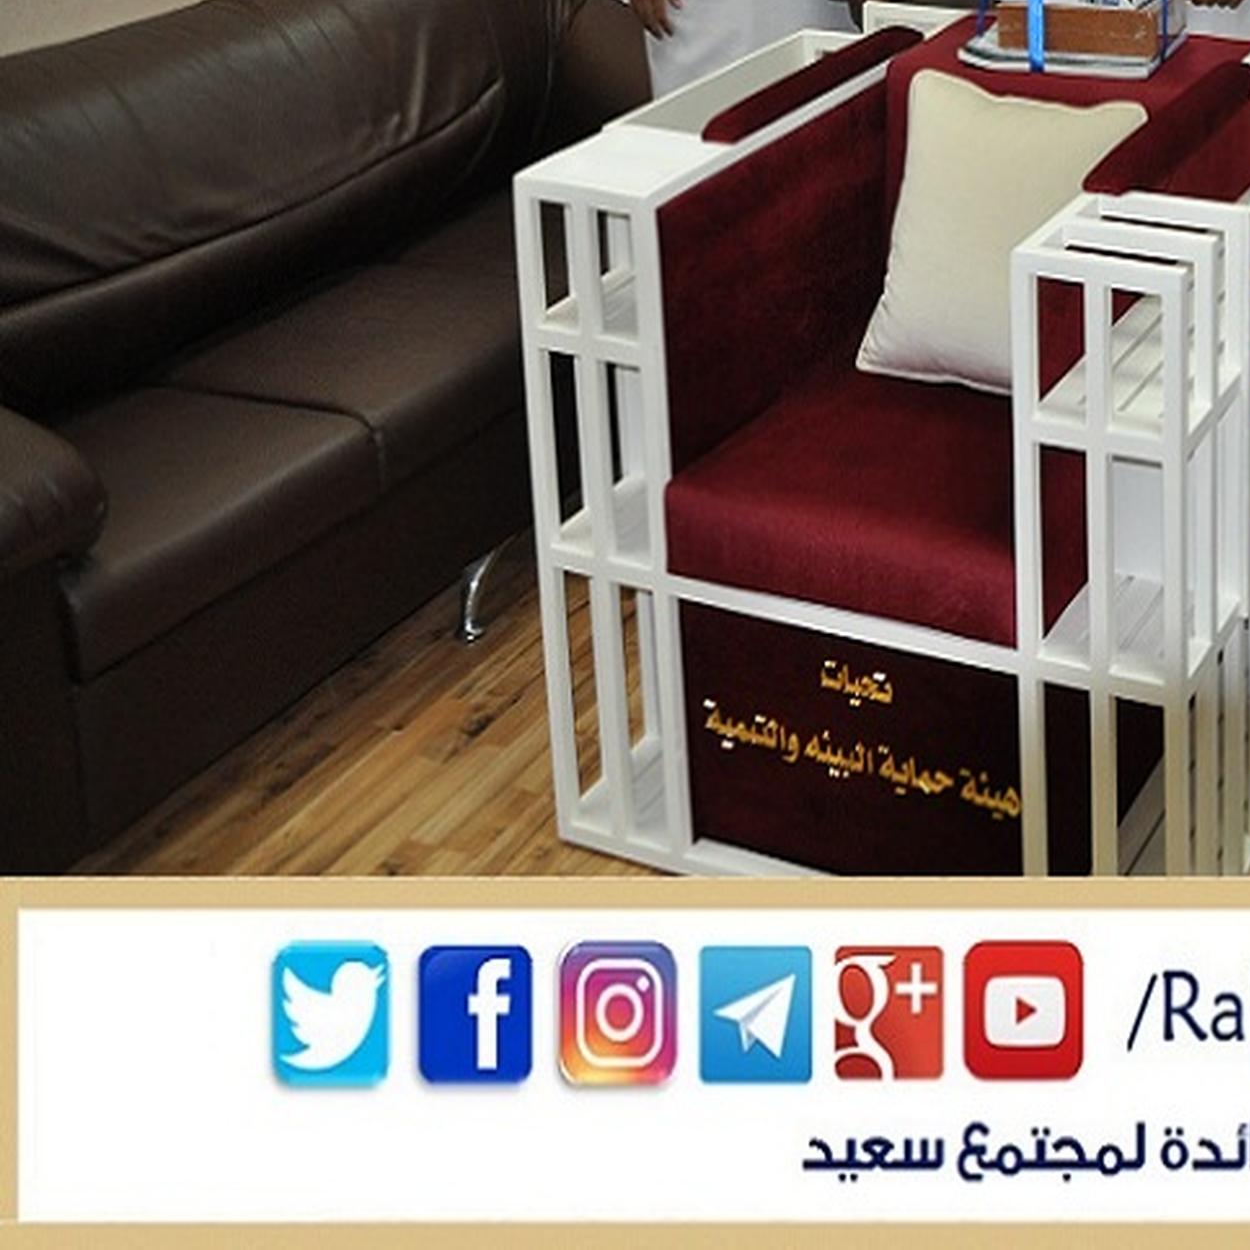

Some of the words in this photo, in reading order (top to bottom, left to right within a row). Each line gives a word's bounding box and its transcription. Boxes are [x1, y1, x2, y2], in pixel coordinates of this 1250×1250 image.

[820, 660, 894, 707] تحيات
[702, 699, 800, 763] والتنمية
[878, 745, 954, 796] حماية
